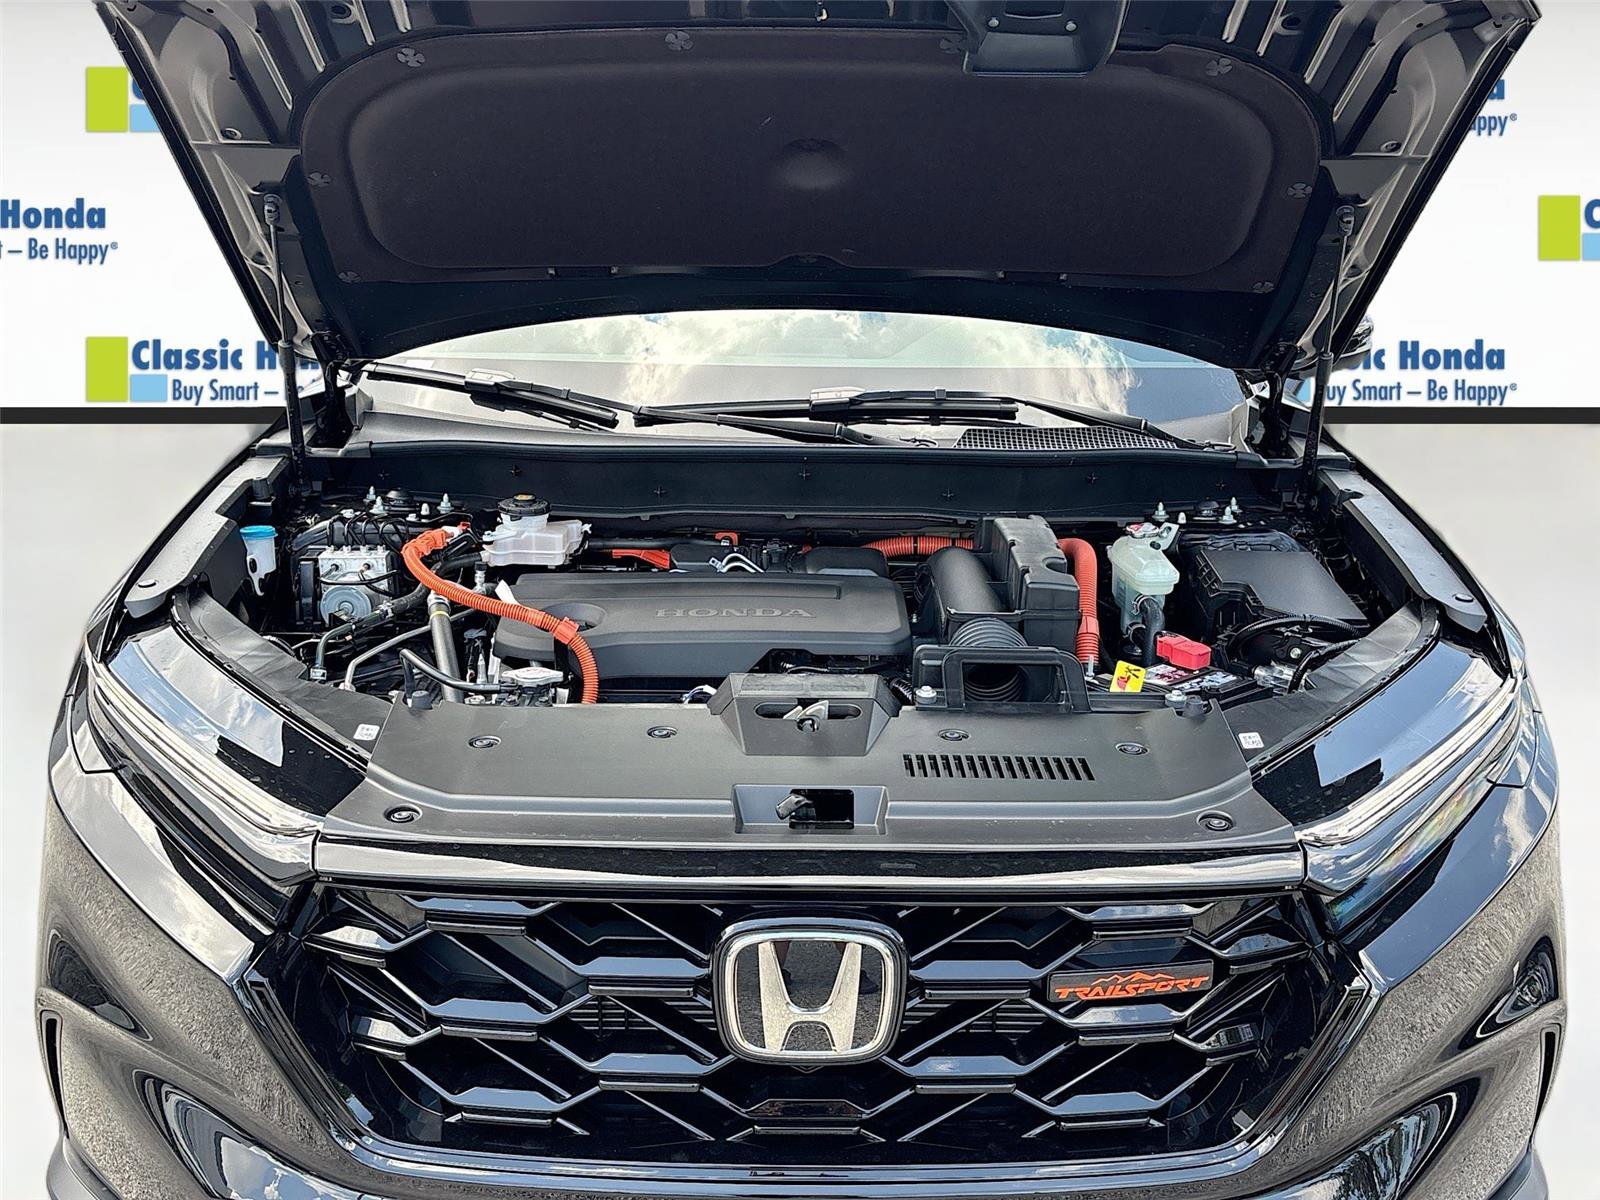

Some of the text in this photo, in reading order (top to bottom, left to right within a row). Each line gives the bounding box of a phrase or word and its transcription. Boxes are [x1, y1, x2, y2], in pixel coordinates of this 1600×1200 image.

[0, 197, 106, 229] Honda
[28, 237, 48, 260] Be
[131, 339, 243, 370] Classic
[1399, 338, 1505, 370] Honda
[172, 379, 203, 406] Buy
[209, 378, 259, 401] Smart
[1326, 385, 1347, 405] uy
[1352, 378, 1402, 401] Smart
[1427, 378, 1448, 401] Be
[655, 608, 817, 618] HONDA
[1054, 976, 1210, 1000] TRAILSPORT
